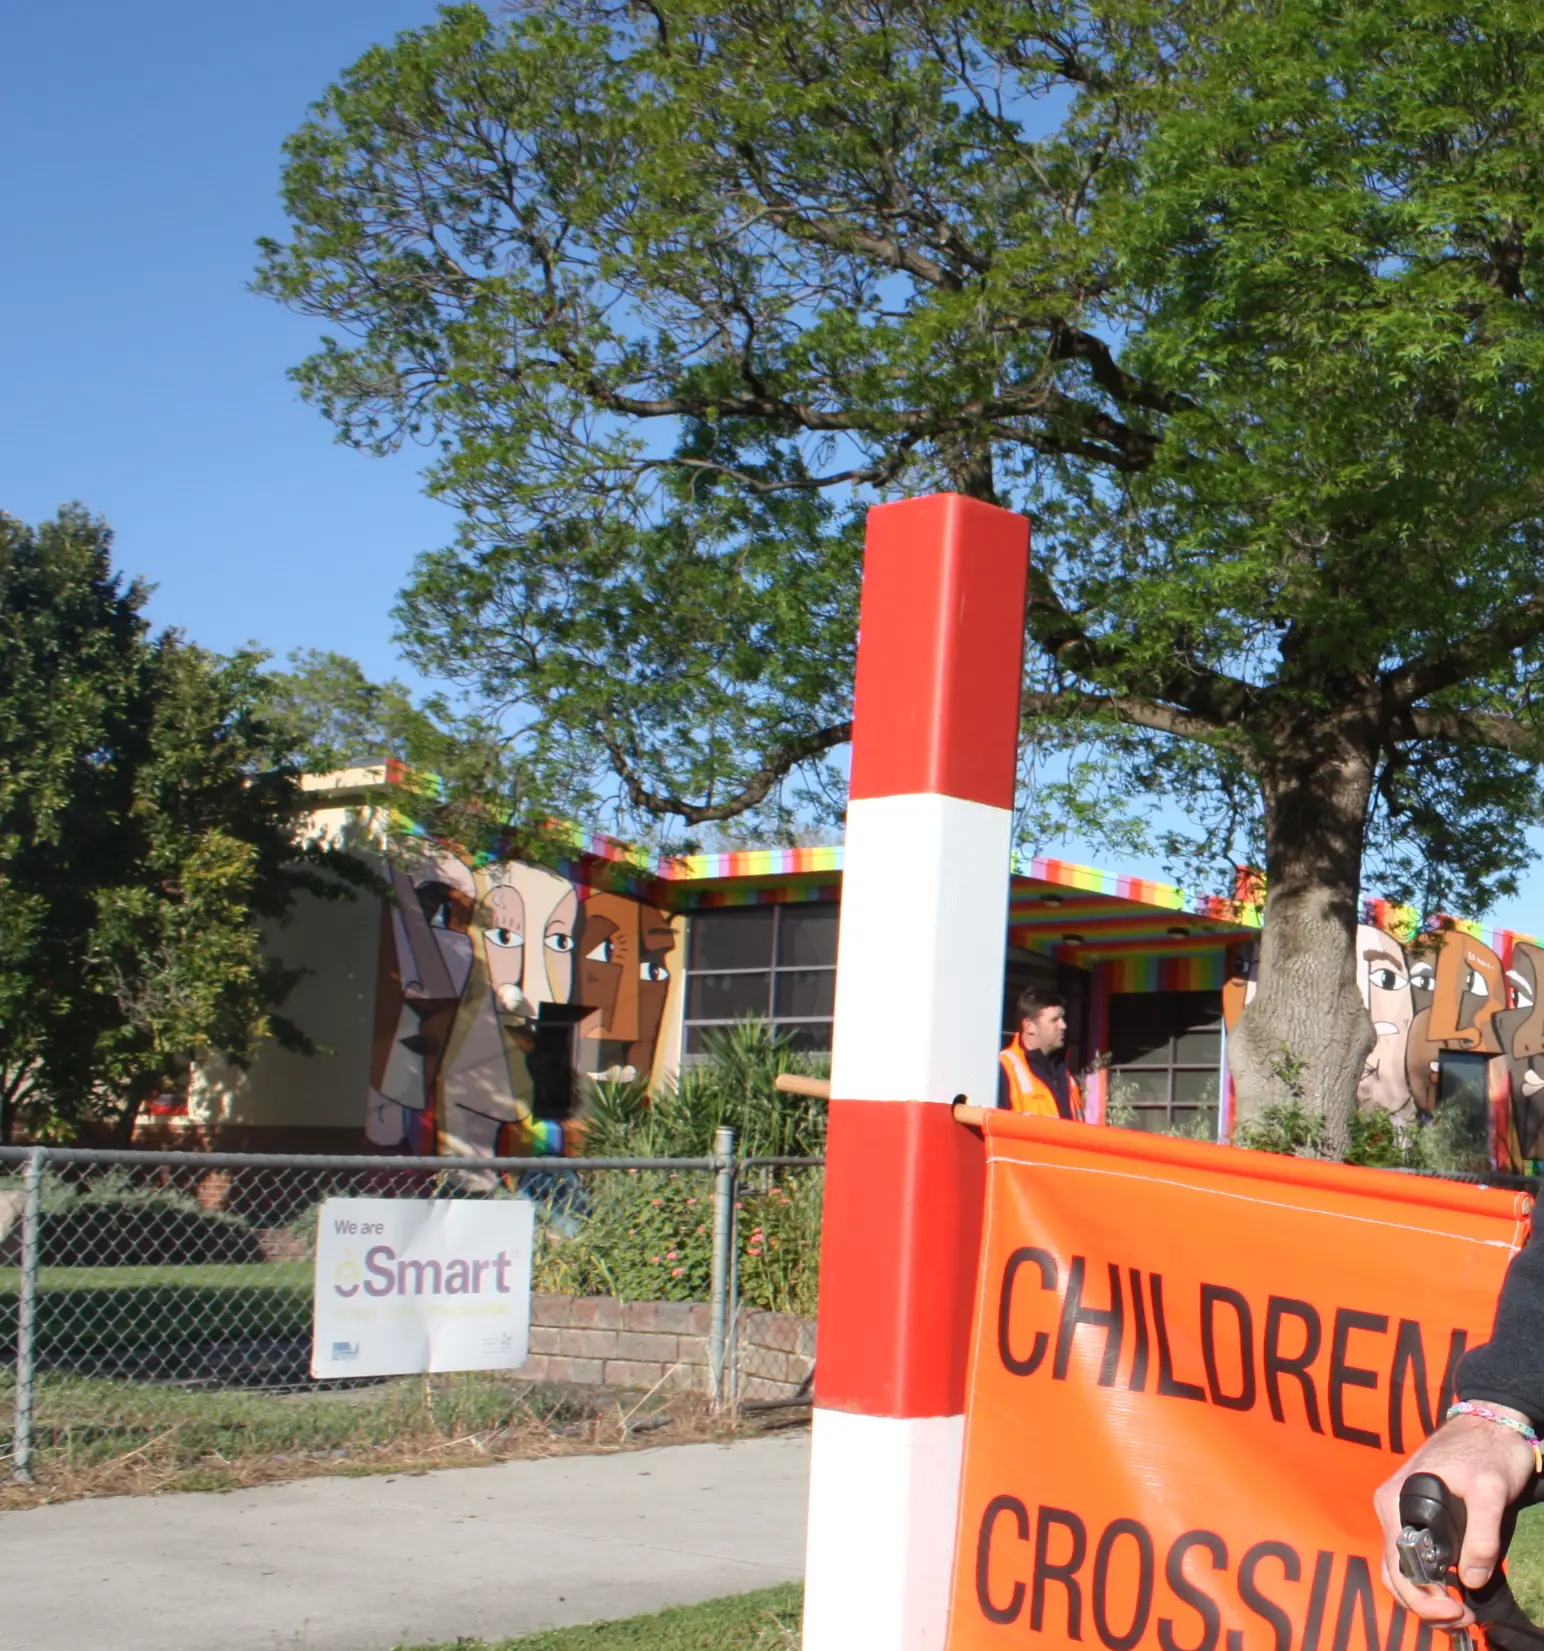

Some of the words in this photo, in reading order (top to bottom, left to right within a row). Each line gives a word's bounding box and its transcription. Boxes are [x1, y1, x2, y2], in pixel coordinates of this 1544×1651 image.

[333, 1219, 358, 1235] We
[360, 1222, 385, 1235] are
[333, 1245, 512, 1298] eSmart
[997, 1246, 1468, 1455] CHILDREN
